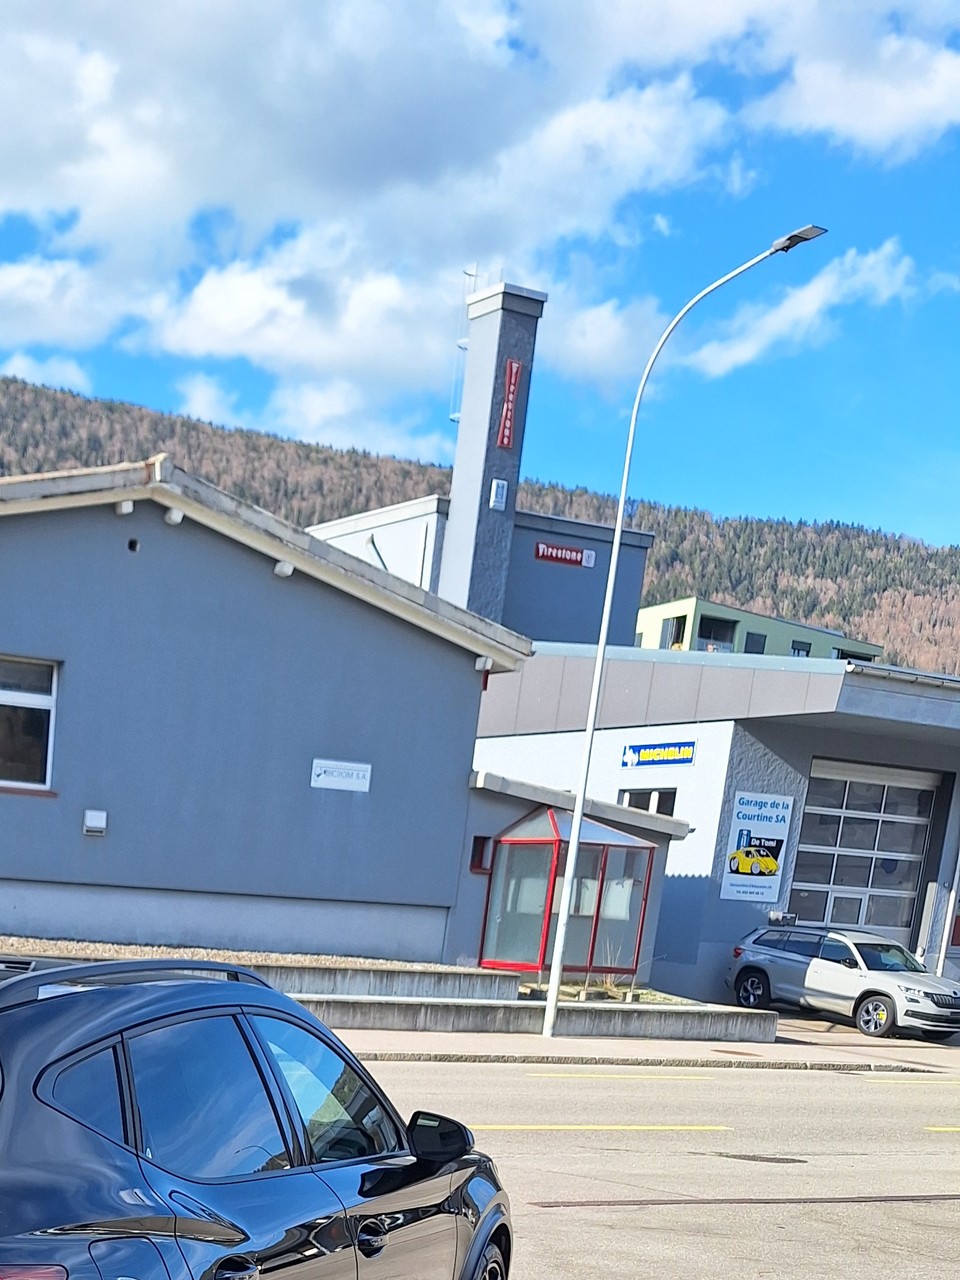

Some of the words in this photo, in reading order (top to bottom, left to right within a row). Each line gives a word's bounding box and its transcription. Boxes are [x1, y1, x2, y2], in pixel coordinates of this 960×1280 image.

[538, 543, 582, 562] Firestone
[639, 746, 693, 761] MICHELIN
[738, 796, 769, 810] Garage
[769, 800, 780, 810] de
[781, 801, 790, 810] la
[736, 811, 773, 822] Courtine
[774, 814, 786, 824] SA
[751, 838, 761, 846] De
